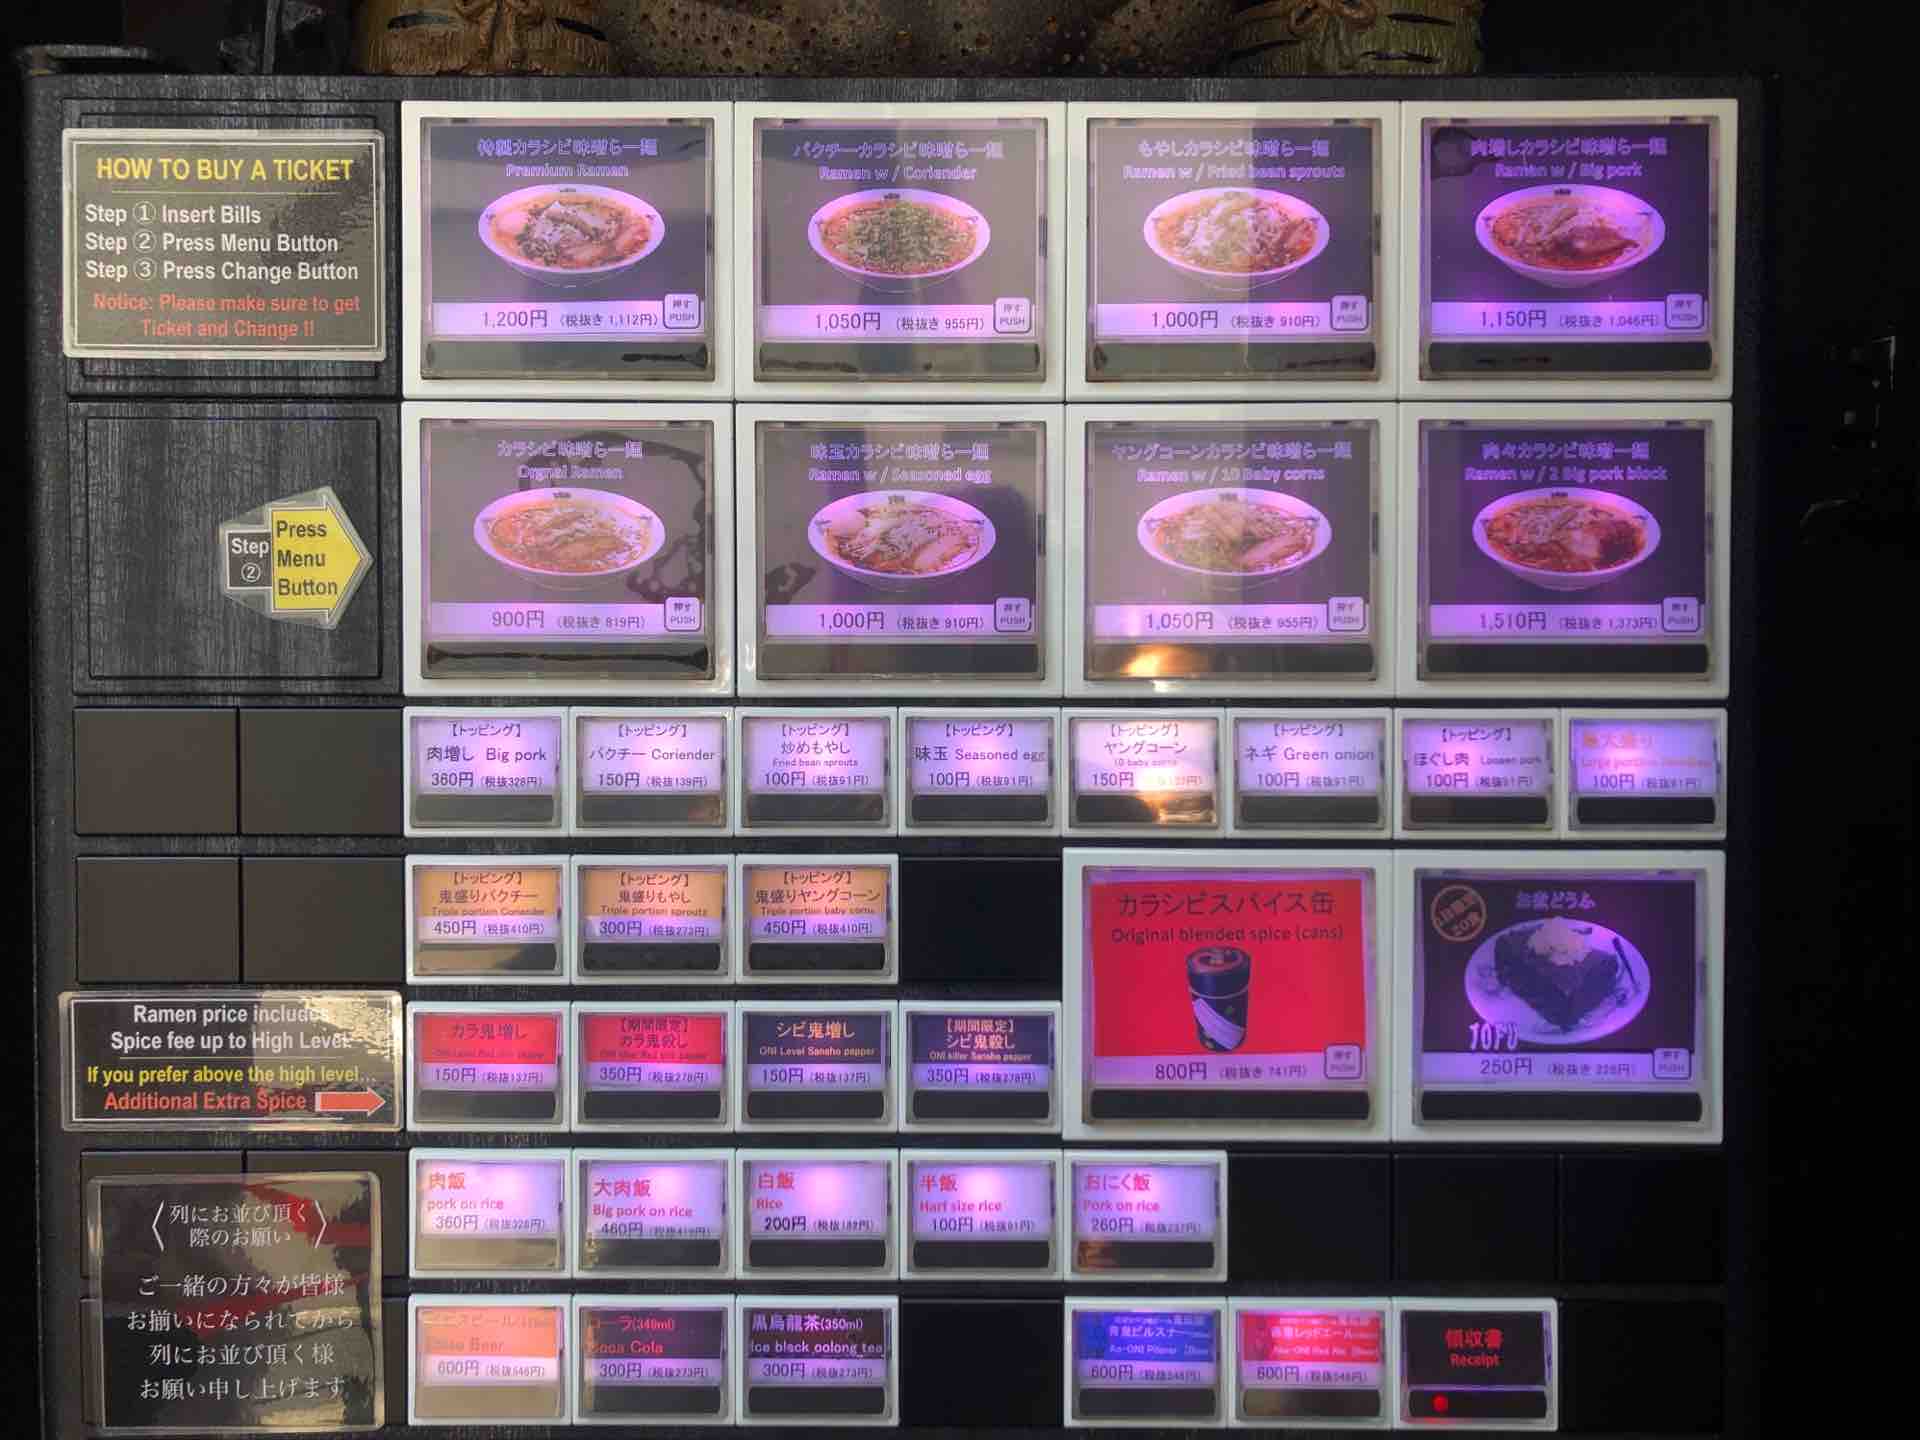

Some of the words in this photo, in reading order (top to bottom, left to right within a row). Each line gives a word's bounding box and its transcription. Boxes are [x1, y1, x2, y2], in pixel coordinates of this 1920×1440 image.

[96, 159, 152, 178] HOW
[160, 159, 190, 179] TO
[197, 159, 241, 179] BUY
[250, 160, 267, 179] A
[273, 160, 354, 181] TICKET
[86, 204, 127, 226] Step
[162, 205, 215, 223] Insert
[221, 206, 261, 224] Bills
[86, 233, 127, 254] Step
[163, 233, 215, 252] Press
[221, 234, 270, 252] Menu
[278, 234, 338, 252] Button
[86, 260, 128, 282] Step
[163, 262, 215, 280] Press
[221, 262, 291, 284] Change
[298, 263, 358, 280] Button
[94, 293, 152, 309] Notice:
[159, 294, 216, 310] Please
[220, 295, 264, 311] make
[270, 298, 309, 311] sure
[313, 296, 328, 311] to
[335, 296, 360, 315] get
[482, 309, 548, 328] 1,200円
[816, 312, 881, 331] 1,050円
[1152, 310, 1218, 329] 1,000円
[1481, 310, 1547, 328] 1,150円
[142, 319, 192, 336] Ticket
[198, 320, 228, 337] and
[234, 320, 297, 341] Change
[276, 520, 327, 537] Press
[232, 538, 269, 558] Step
[277, 550, 326, 567] Menu
[278, 578, 338, 596] Button
[492, 610, 545, 628] 900円
[818, 611, 885, 631] 1,000円
[1146, 611, 1214, 630] 1,050円
[1480, 611, 1547, 630] 1,510円
[427, 746, 474, 762] 肉増し
[486, 747, 509, 763] Big
[514, 747, 547, 762] pork
[915, 746, 949, 761] 味玉
[955, 749, 1018, 760] Seasoned
[1104, 742, 1187, 755] ヤングコーン
[1245, 746, 1278, 761] ネギ
[1284, 747, 1329, 760] Green
[1334, 748, 1374, 761] onion
[599, 772, 640, 787] 150円
[764, 771, 805, 786] 100円
[928, 772, 969, 786] 100円
[1092, 772, 1133, 787] 150円
[1257, 772, 1300, 787] 100円
[1427, 773, 1468, 787] 100円
[1593, 774, 1634, 788] 100円
[1119, 891, 1335, 917] カラシビスパイス缶
[432, 920, 476, 936] 450円
[600, 920, 642, 936] 300円
[763, 920, 806, 936] 450円
[1112, 928, 1174, 945] Original
[134, 1005, 196, 1023] Ramen
[202, 1006, 248, 1028] price
[111, 1031, 162, 1052] Spice
[167, 1032, 195, 1049] fee
[201, 1036, 223, 1053] up
[228, 1033, 247, 1049] to
[252, 1032, 293, 1052] High
[435, 1067, 476, 1083] 150円
[599, 1067, 642, 1083] 350円
[1155, 1061, 1207, 1081] 800円
[1480, 1057, 1532, 1076] 250円
[88, 1067, 97, 1082] If
[103, 1070, 133, 1086] you
[139, 1066, 189, 1086] prefer
[193, 1067, 243, 1082] above
[248, 1067, 276, 1082] the
[279, 1066, 315, 1086] high
[762, 1068, 803, 1083] 150円
[927, 1068, 969, 1084] 350円
[104, 1092, 197, 1110] Additional
[204, 1092, 250, 1109] Extra
[256, 1090, 305, 1113] Spice
[427, 1198, 457, 1211] pork
[617, 1204, 647, 1217] pork
[673, 1206, 693, 1217] rice
[170, 1204, 306, 1224] 列にお並び頂く
[765, 1216, 806, 1231] 200円
[933, 1217, 973, 1232] 100円
[1090, 1217, 1134, 1233] 260円
[630, 1340, 663, 1354] Cola
[776, 1340, 809, 1353] black
[599, 1363, 642, 1378] 300円
[762, 1363, 805, 1378] 300円
